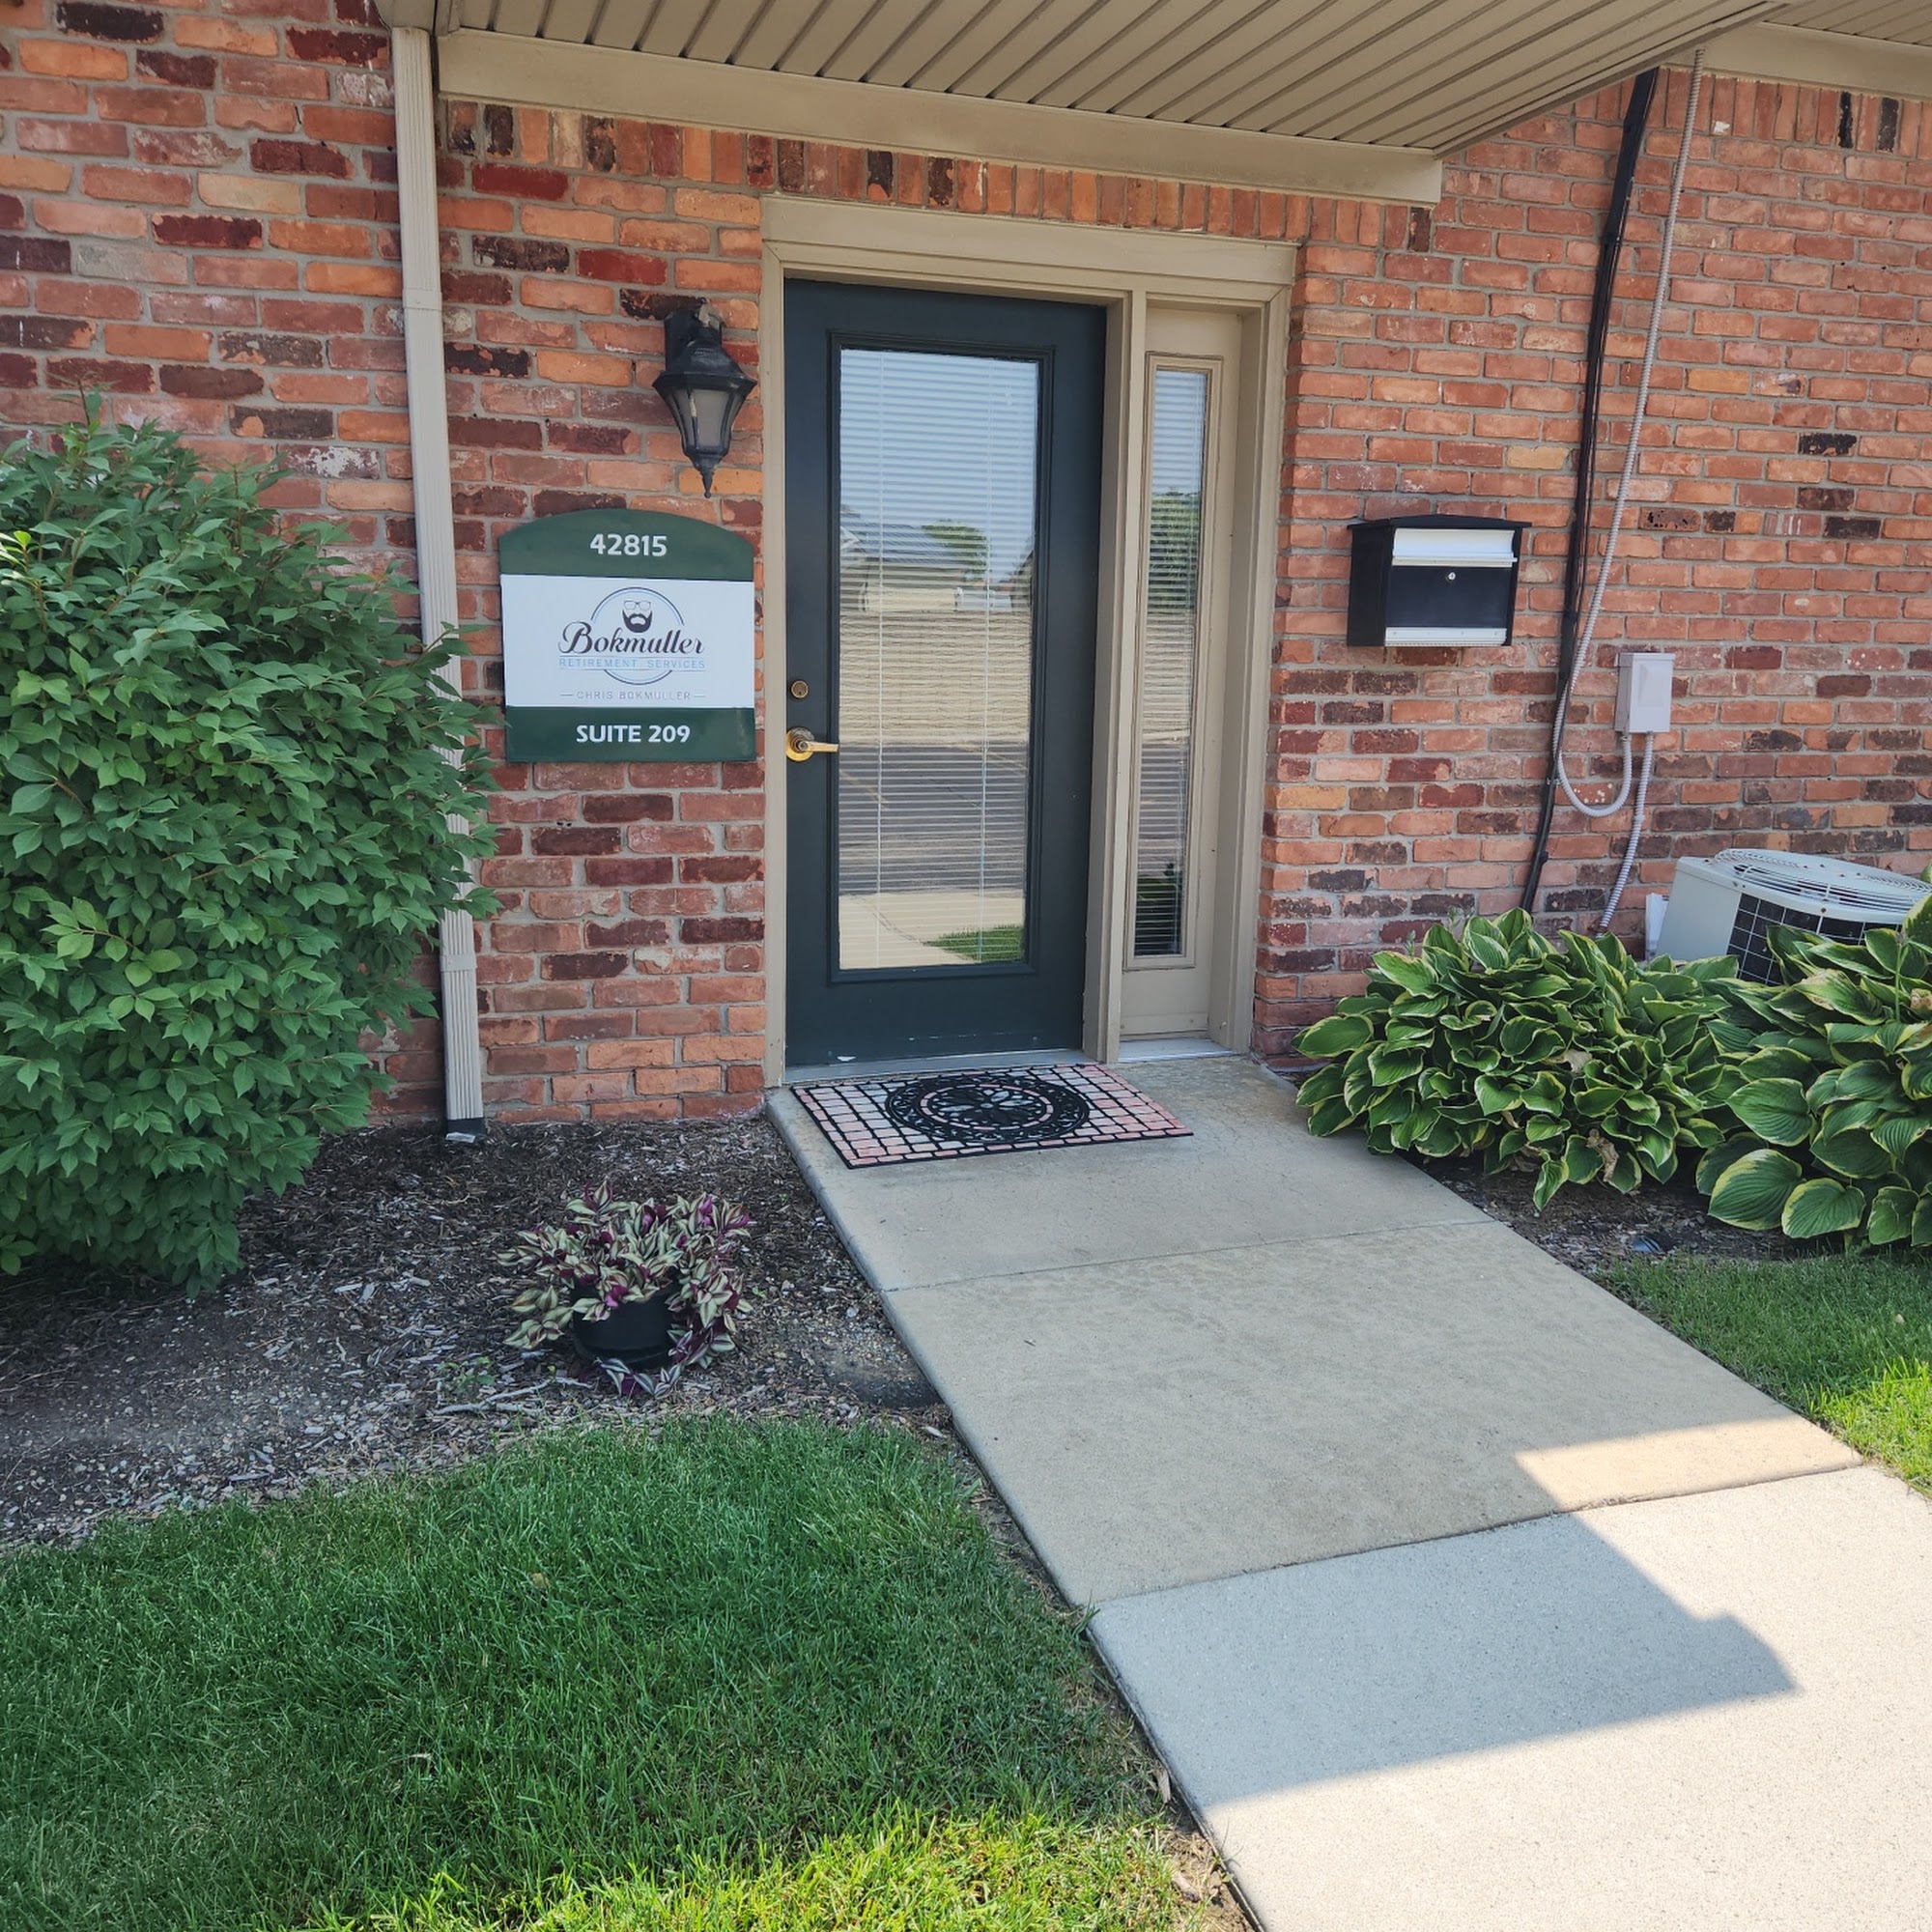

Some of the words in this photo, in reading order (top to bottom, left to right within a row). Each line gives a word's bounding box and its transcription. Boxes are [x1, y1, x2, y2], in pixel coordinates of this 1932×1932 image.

[590, 533, 668, 557] 42815
[558, 621, 705, 655] Bokmuller
[558, 658, 638, 668] RETIREMENT
[647, 659, 705, 669] SERVICES
[577, 691, 613, 700] CHRIS
[619, 692, 691, 701] BOKMULLER
[576, 724, 641, 743] SUITE
[647, 724, 691, 743] 209
